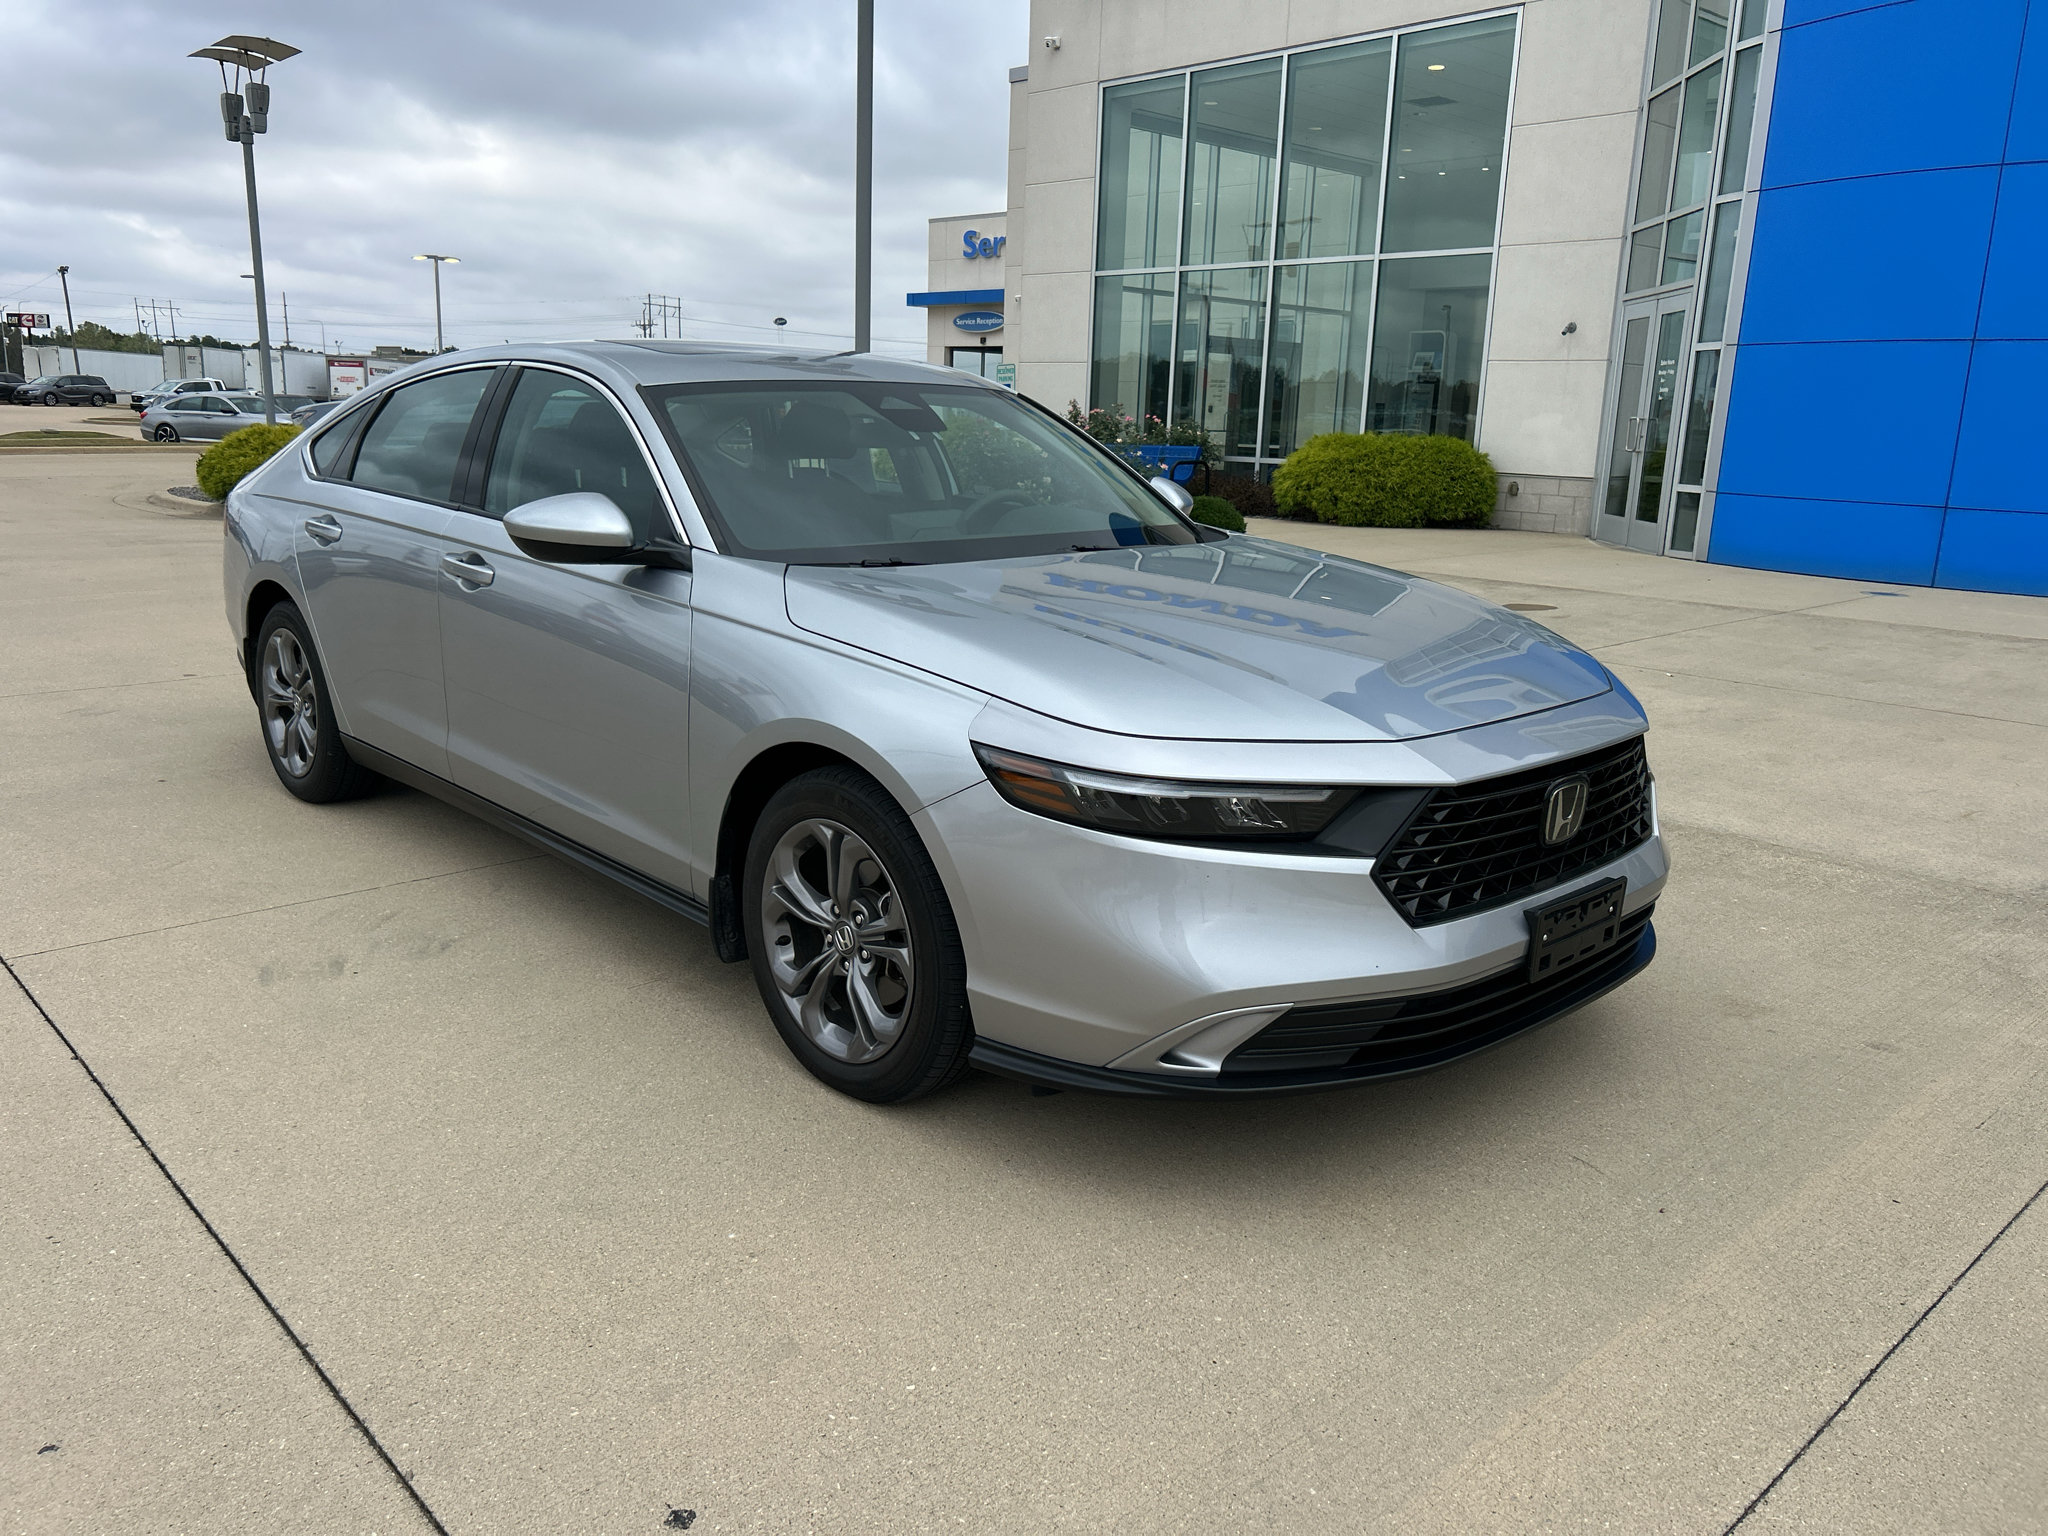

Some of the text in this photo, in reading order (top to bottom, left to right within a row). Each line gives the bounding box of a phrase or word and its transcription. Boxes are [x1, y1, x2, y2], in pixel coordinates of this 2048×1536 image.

[963, 229, 1006, 259] Ser
[8, 316, 19, 324] CAT
[976, 317, 1003, 326] Reception
